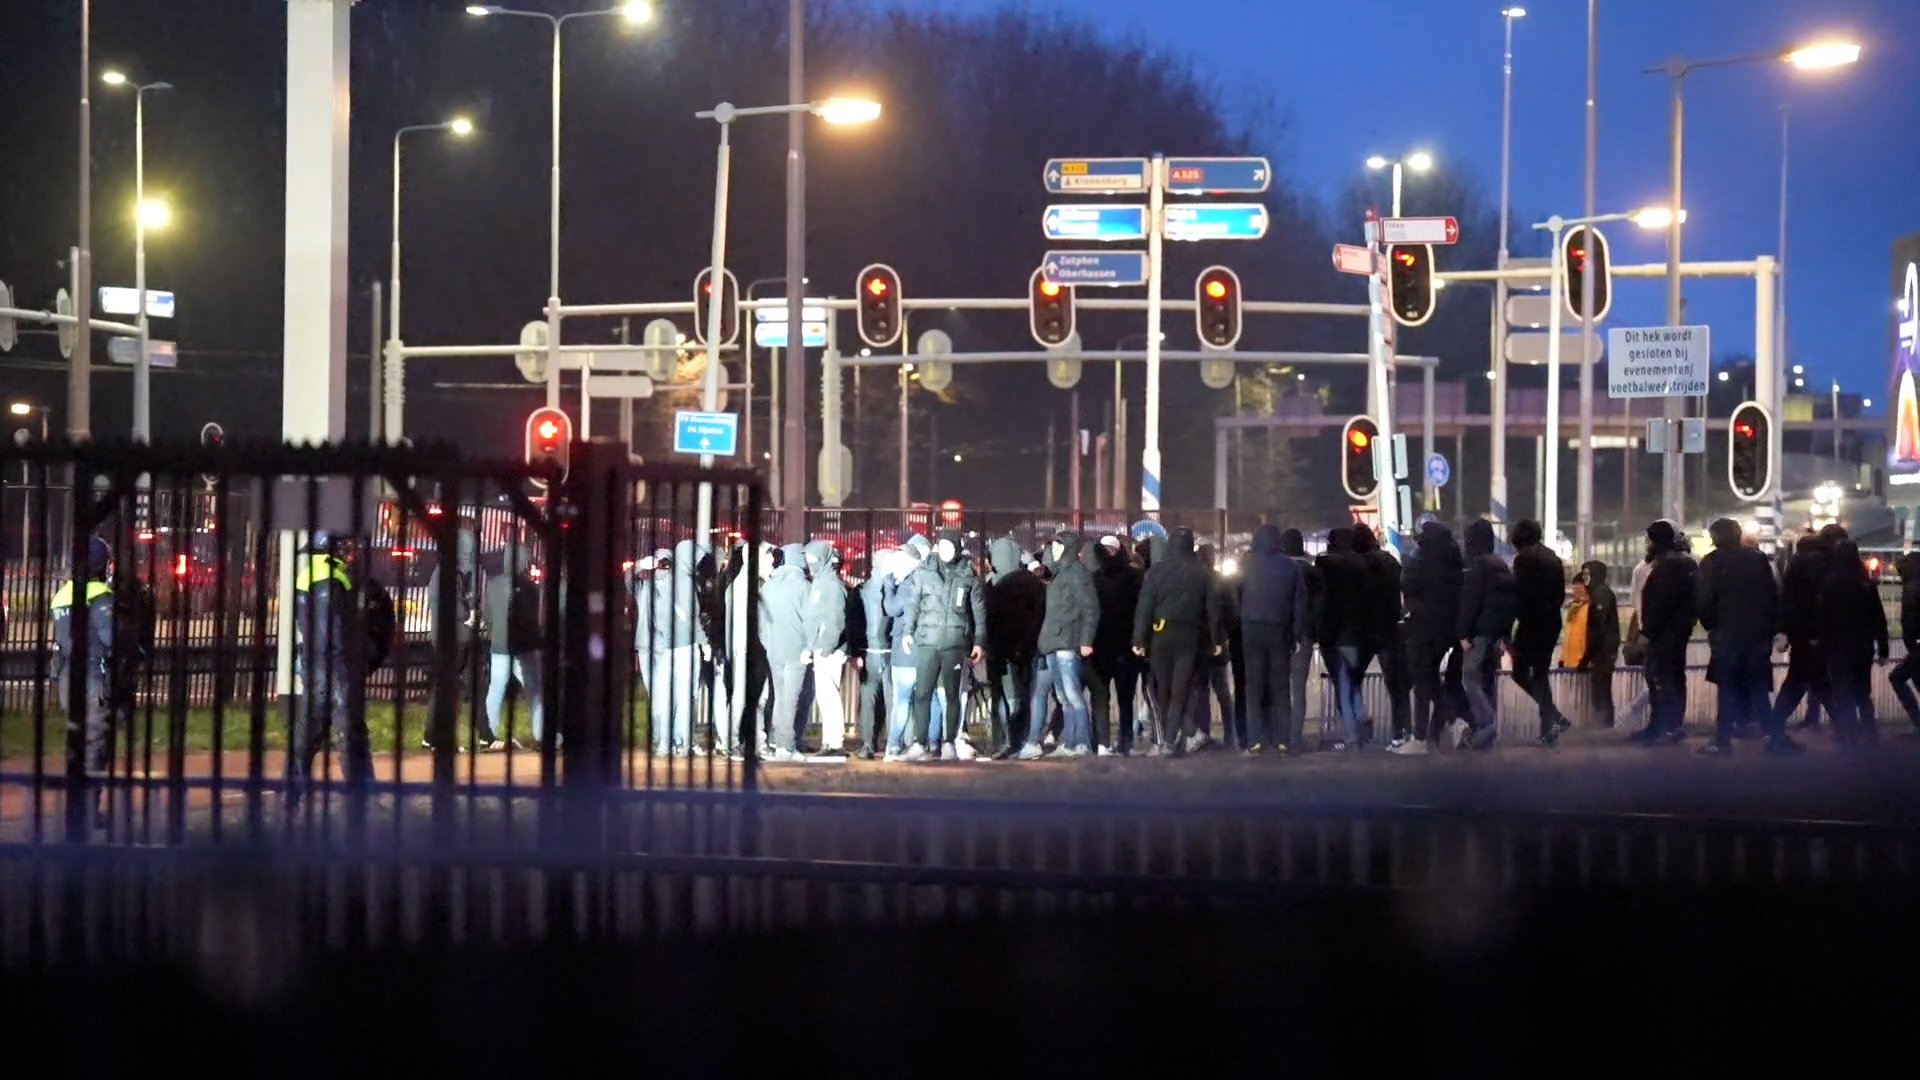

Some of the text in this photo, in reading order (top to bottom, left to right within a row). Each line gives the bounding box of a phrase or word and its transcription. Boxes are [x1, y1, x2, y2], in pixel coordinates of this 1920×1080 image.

[1173, 169, 1199, 179] A325
[1060, 256, 1099, 266] Zutphen
[1058, 270, 1116, 278] Oberhausen
[1625, 330, 1692, 343] Dit hek wordt
[1629, 347, 1688, 362] gesloten bij
